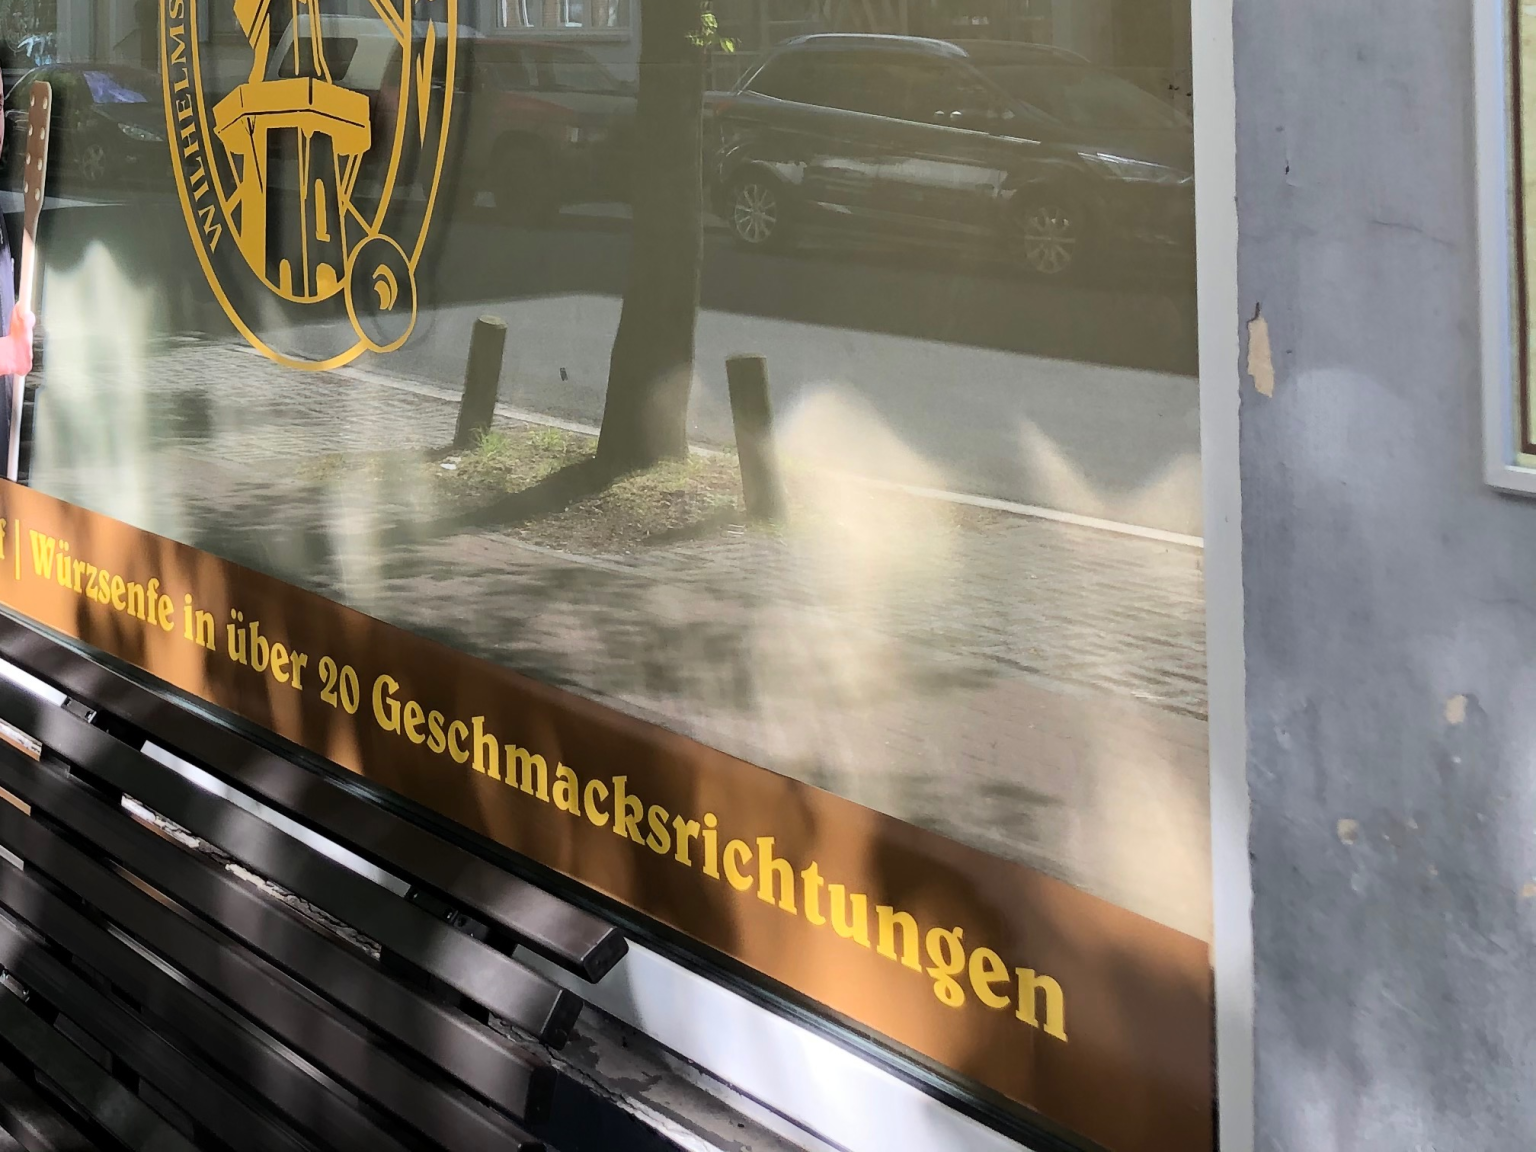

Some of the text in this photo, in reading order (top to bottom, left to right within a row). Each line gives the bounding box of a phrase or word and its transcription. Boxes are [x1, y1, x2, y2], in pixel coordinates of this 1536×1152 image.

[28, 528, 175, 632] Würzsenfe
[183, 594, 216, 651] in
[227, 608, 308, 690] über
[318, 656, 361, 715] 20
[372, 672, 1069, 1042] Geschmacksrichtungen
